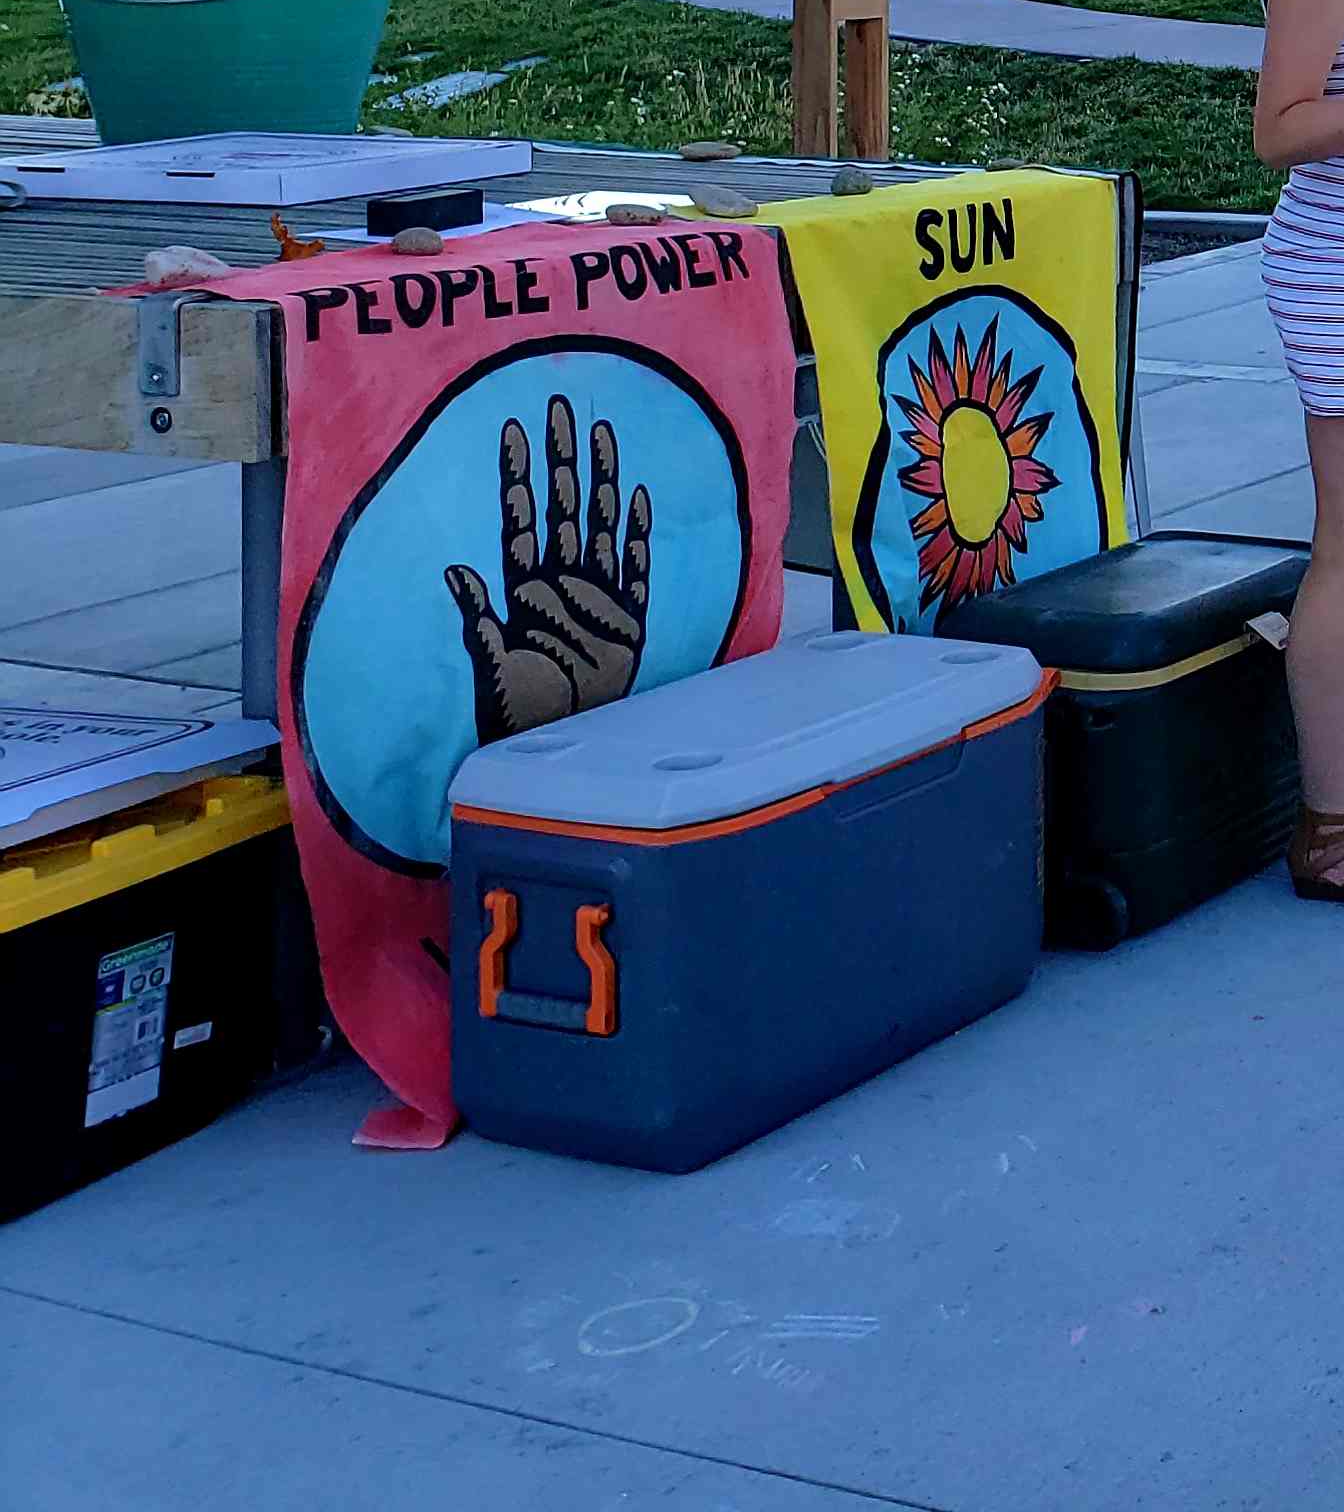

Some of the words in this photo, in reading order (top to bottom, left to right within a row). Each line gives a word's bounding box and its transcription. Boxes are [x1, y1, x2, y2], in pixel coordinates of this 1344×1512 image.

[913, 197, 1017, 281] SUN
[300, 256, 551, 342] PEOPLE
[570, 230, 750, 311] POWER
[61, 724, 159, 738] your
